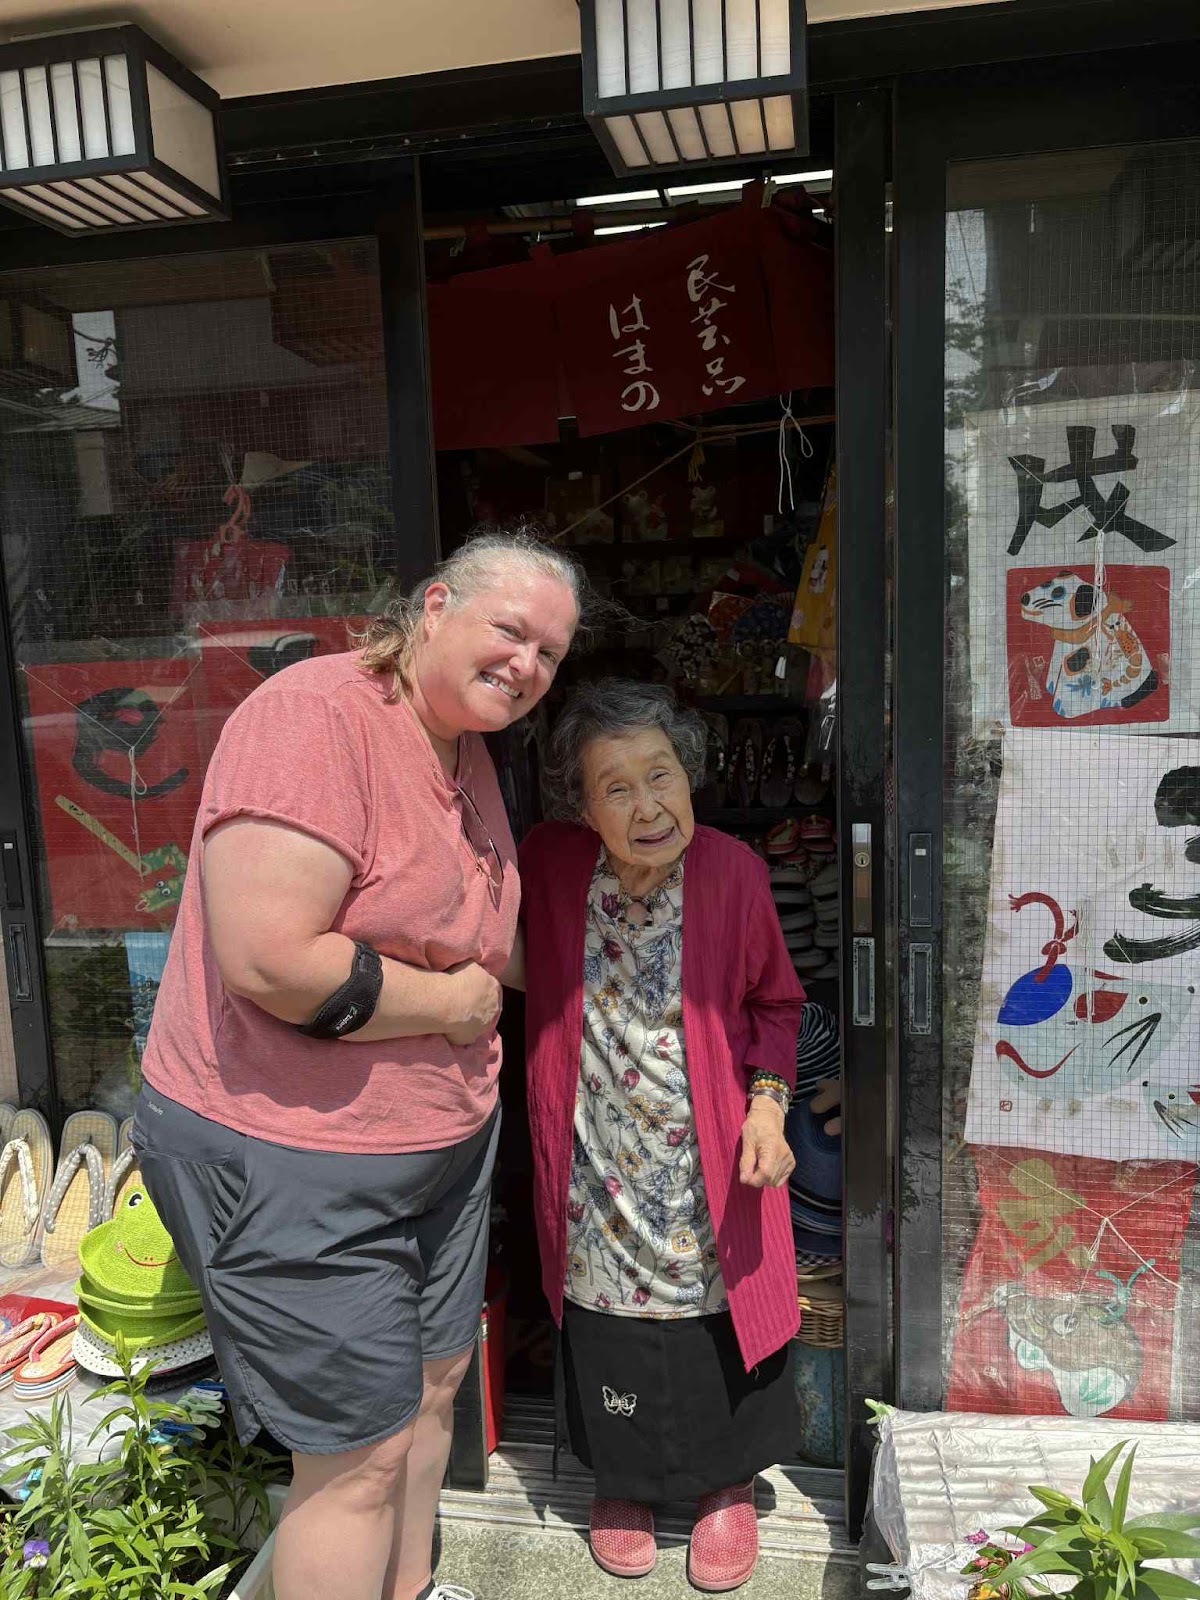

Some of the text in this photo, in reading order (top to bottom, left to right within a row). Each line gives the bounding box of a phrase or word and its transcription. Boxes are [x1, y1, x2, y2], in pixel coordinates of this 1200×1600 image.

[609, 293, 660, 413] はまの
[685, 254, 746, 397] 民芸品
[1006, 424, 1179, 556] 戌
